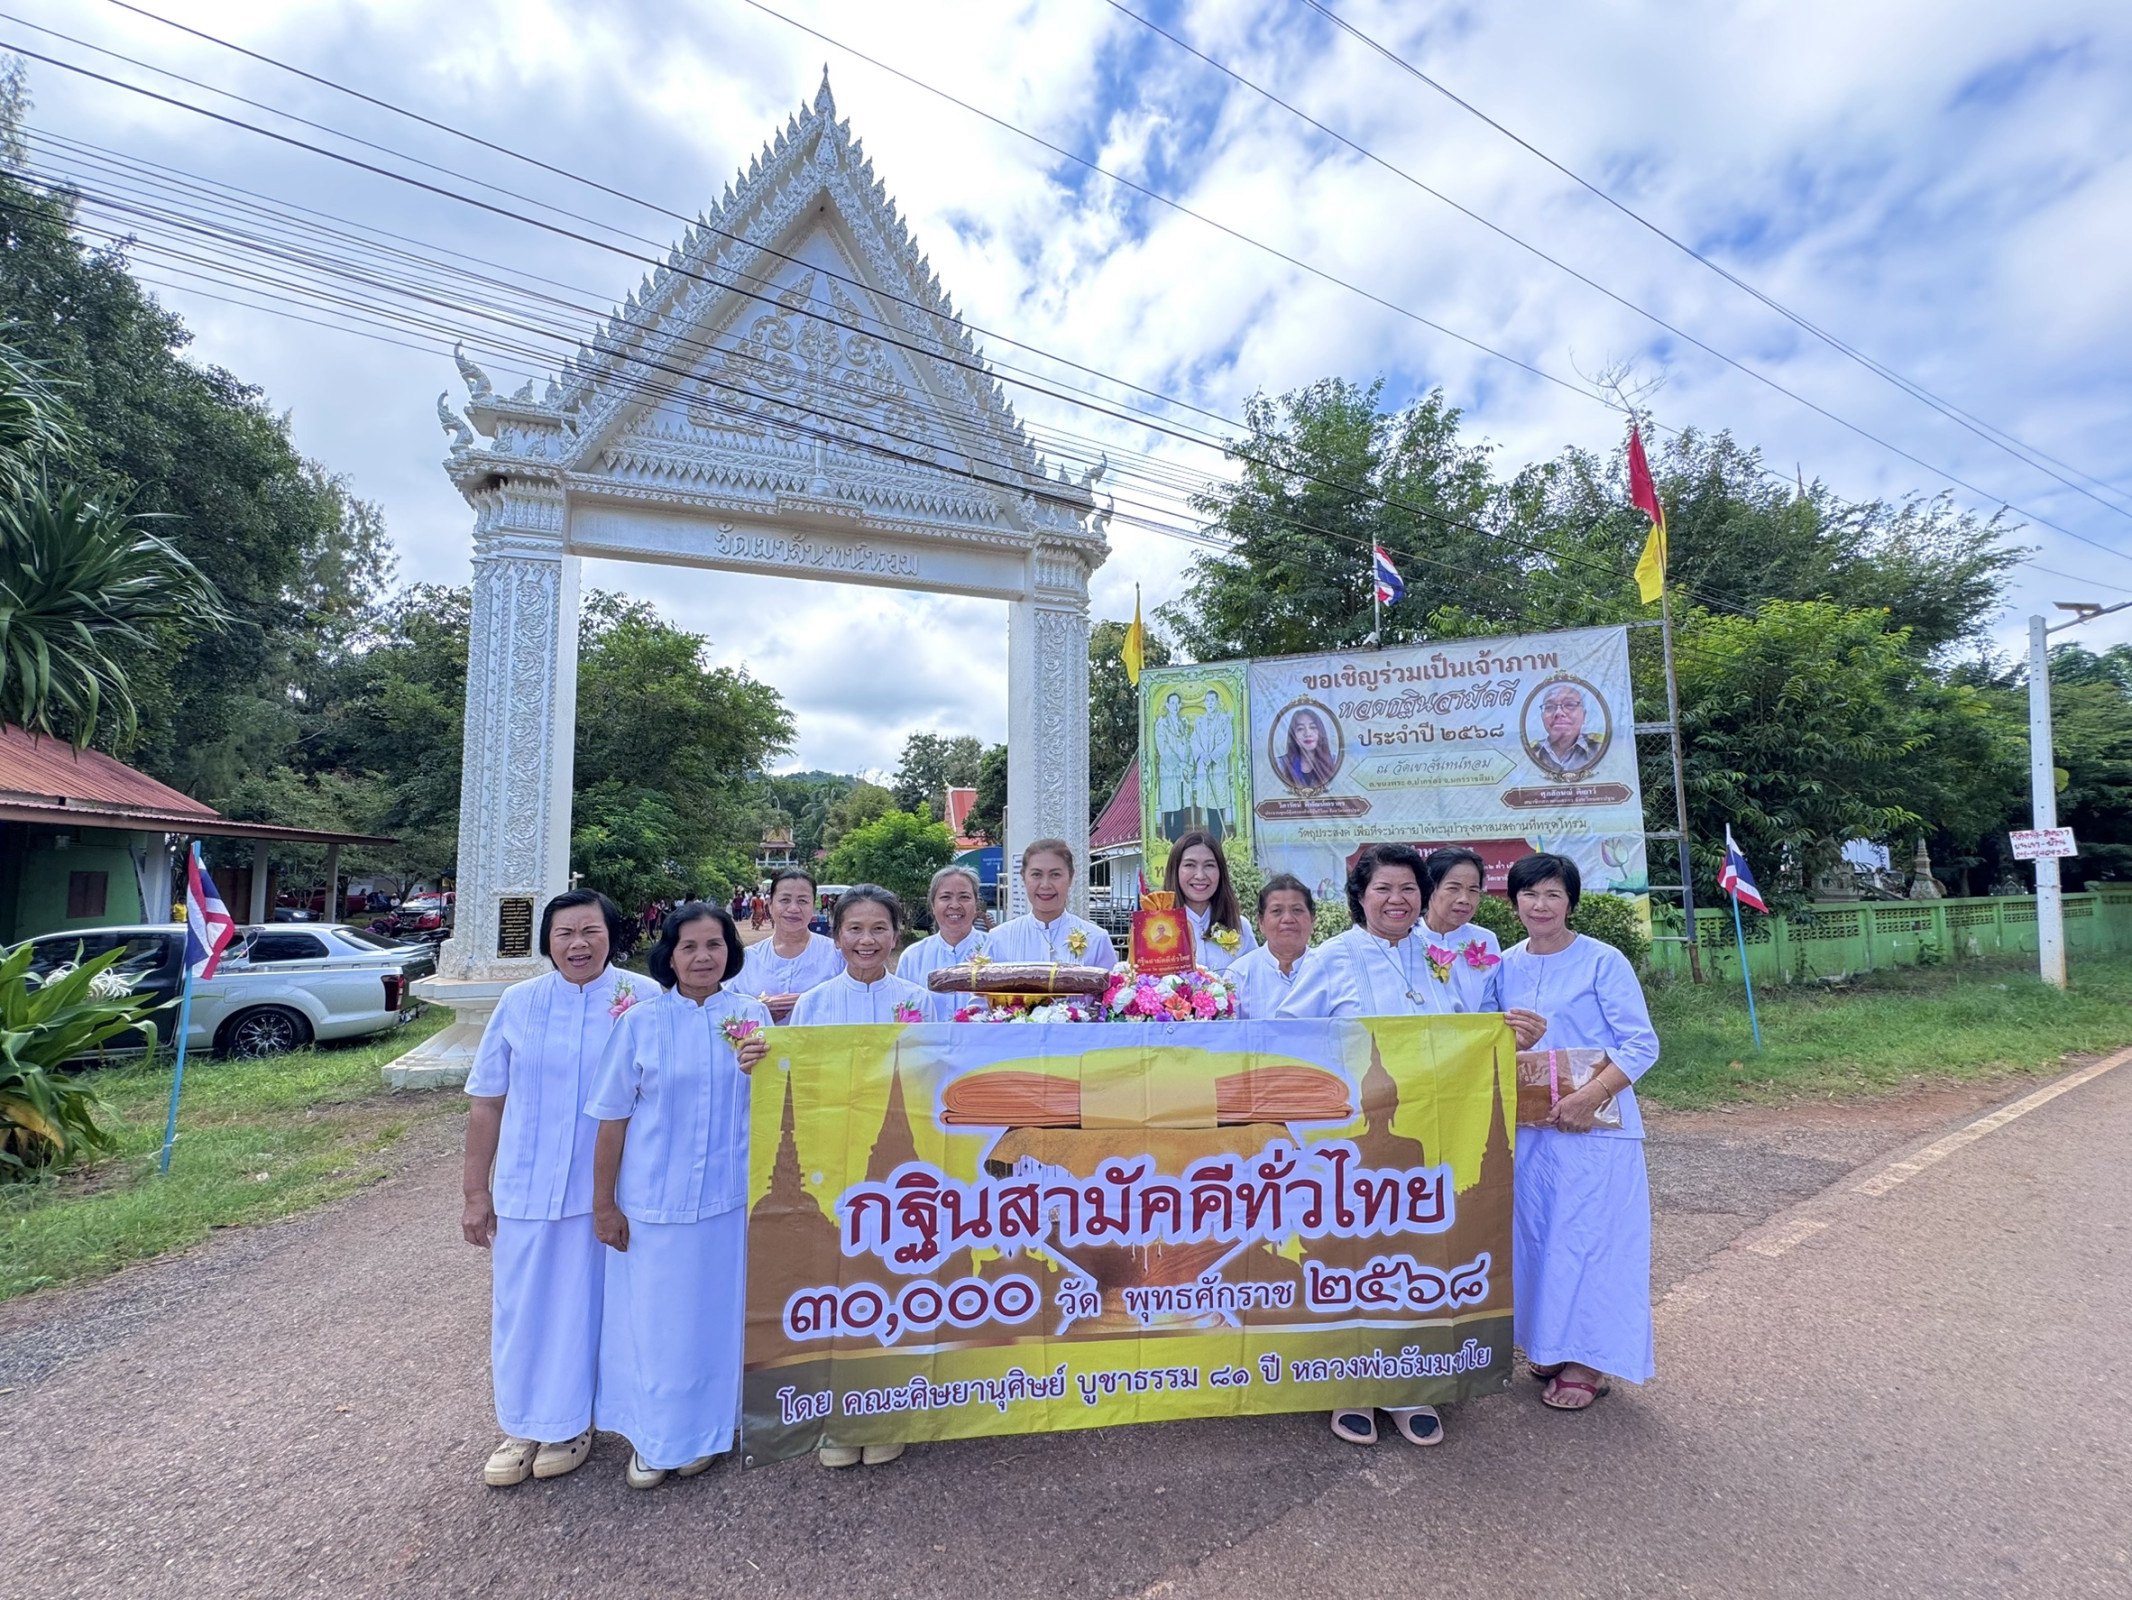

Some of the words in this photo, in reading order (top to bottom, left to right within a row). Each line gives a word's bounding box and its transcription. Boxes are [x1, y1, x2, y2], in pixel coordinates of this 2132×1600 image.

[1302, 650, 1558, 692] ขอเชิญร่วมเป็นเจ้าภาพ
[1338, 679, 1520, 721] ทอดกฐินสามัคคี
[1358, 723, 1434, 747] ประจำปี
[1441, 724, 1504, 741] ๒๕๖๘
[1376, 764, 1388, 774] ณ
[1298, 828, 1351, 841] วัตถุประสงค์
[847, 1148, 1446, 1263] กฐินสามัคคีทั่วไทย
[790, 1280, 1034, 1338] ๓๐,๐๐๐
[1058, 1281, 1099, 1317] วัด
[1125, 1277, 1292, 1322] พุทธศักราช
[1310, 1258, 1487, 1305] ๒๕๖๘
[780, 1387, 832, 1423] โดย
[844, 1363, 1066, 1415] คณะศิษยานุศิษย์
[1077, 1365, 1199, 1404] บูชาธรรม
[1210, 1364, 1250, 1387] ๘๑
[1260, 1354, 1280, 1383] ปี
[1292, 1341, 1491, 1381] หลวงพ่อธัมมชโย
